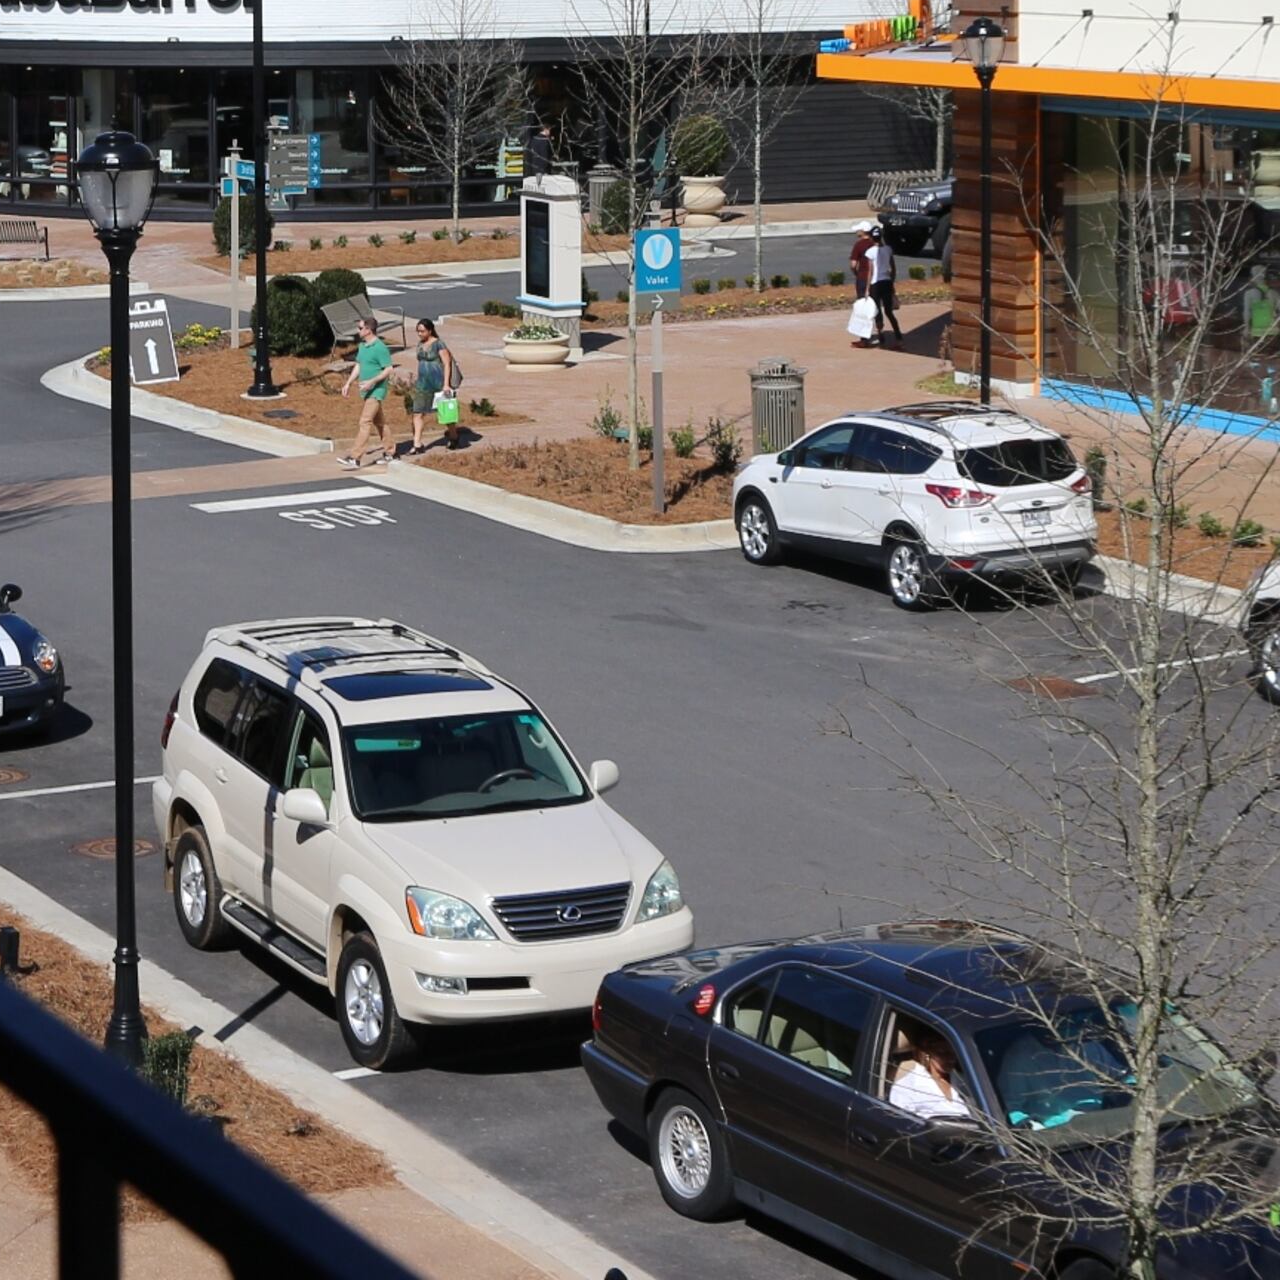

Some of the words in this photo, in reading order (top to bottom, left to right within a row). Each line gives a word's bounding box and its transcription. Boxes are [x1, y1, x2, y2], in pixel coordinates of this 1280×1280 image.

[645, 276, 669, 285] Valet
[129, 319, 164, 330] PARKING
[278, 504, 398, 530] STOP
